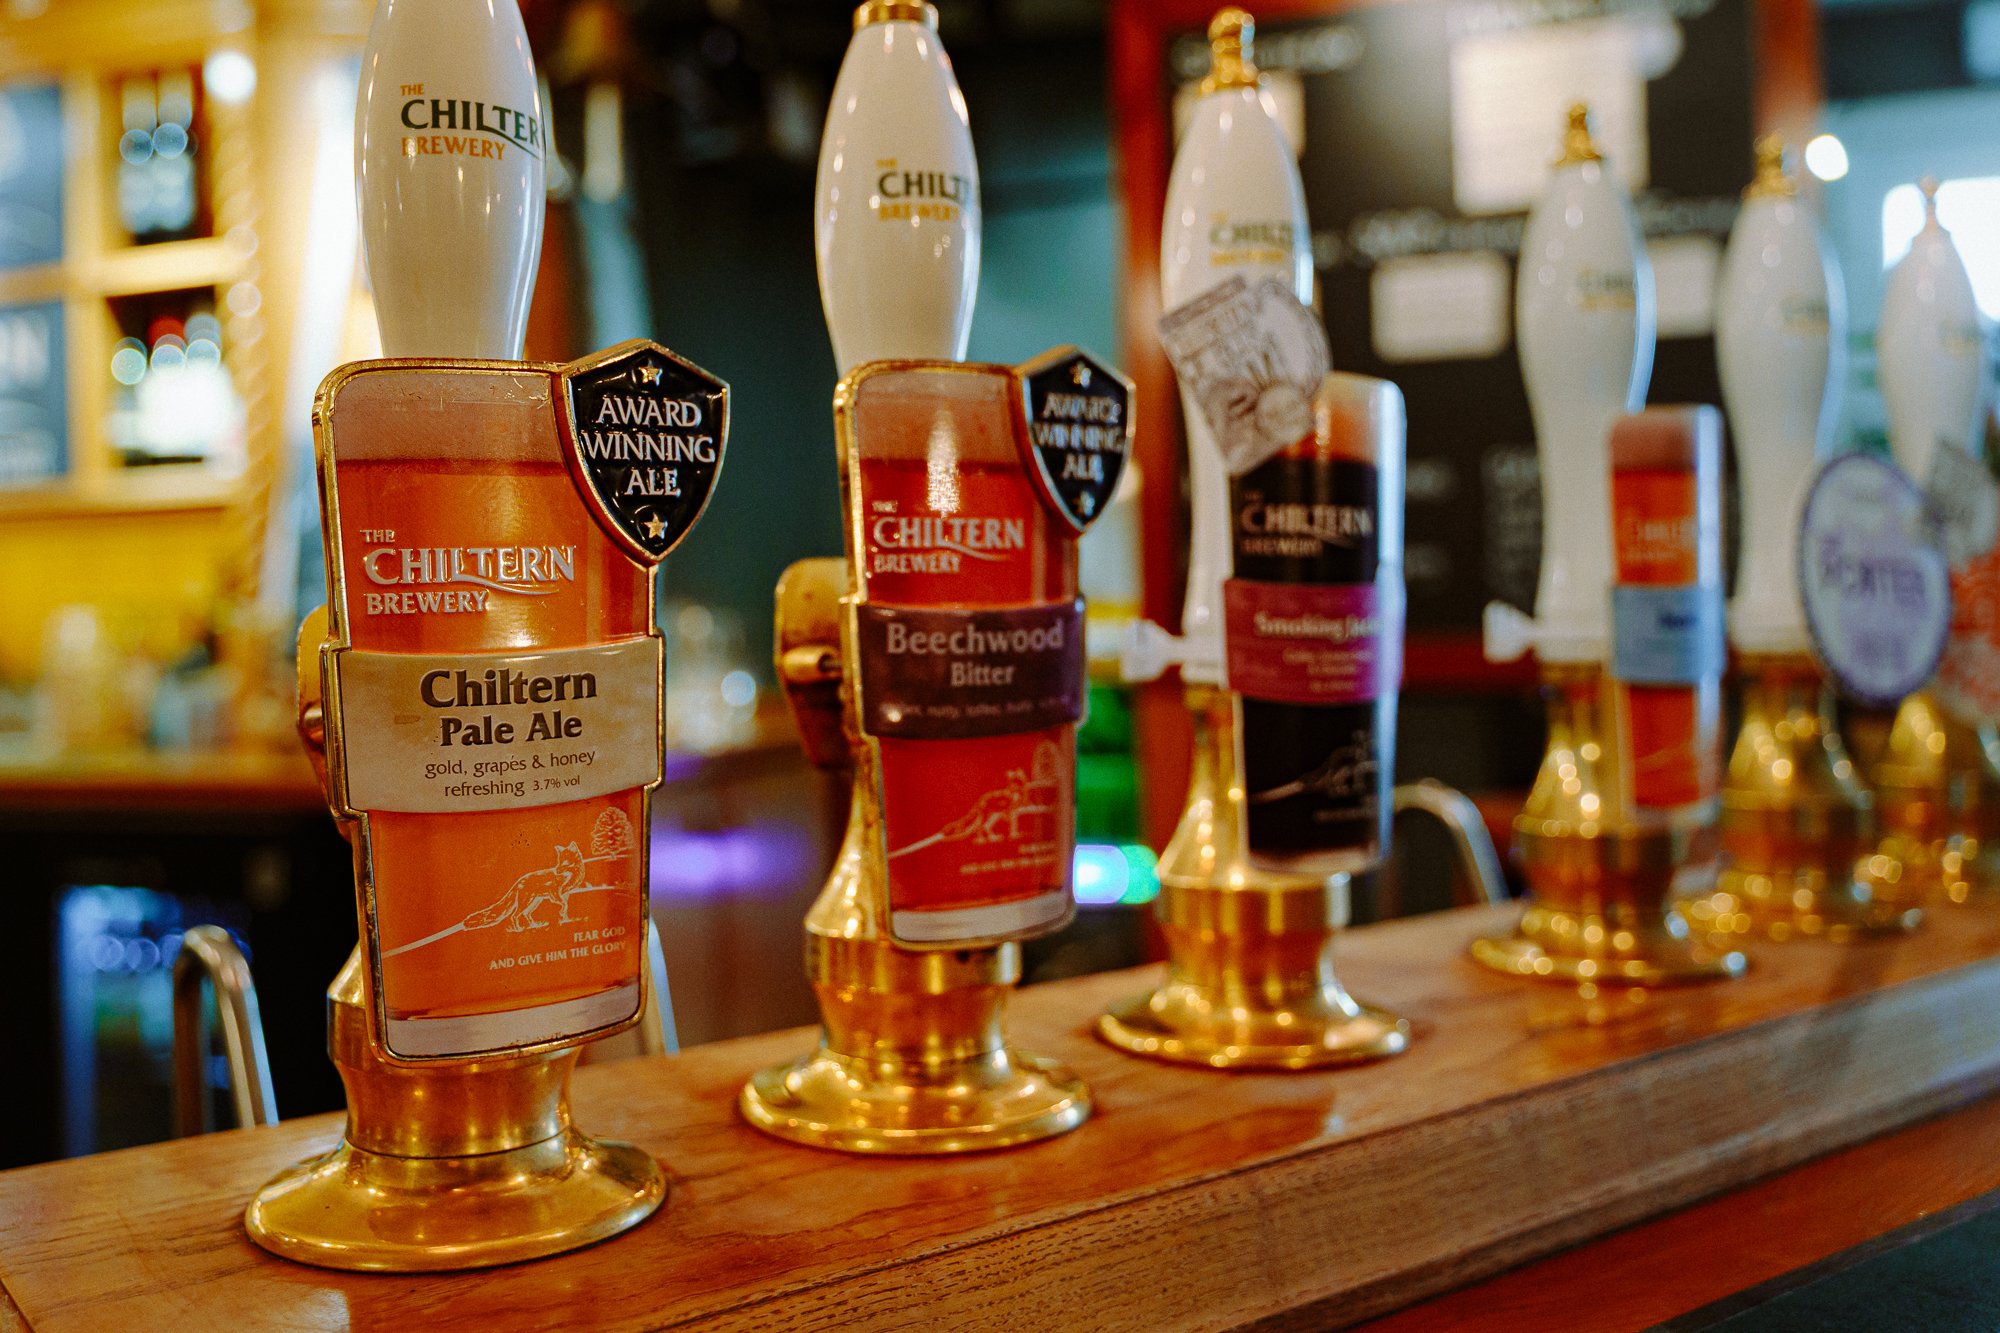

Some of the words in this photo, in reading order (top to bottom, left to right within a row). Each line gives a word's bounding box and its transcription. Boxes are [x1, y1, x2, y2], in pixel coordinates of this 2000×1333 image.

[400, 83, 424, 96] THE
[596, 396, 702, 427] AWARD
[580, 430, 717, 463] WINNING
[625, 468, 682, 496] ALE
[360, 530, 396, 544] THE
[872, 516, 1025, 561] CHILTERN
[363, 545, 578, 595] CHILTERN
[873, 553, 960, 574] BREWERY
[367, 591, 488, 616] BREWERY
[886, 619, 1065, 655] Beechwood
[420, 668, 598, 708] Chiltern
[950, 661, 1016, 688] Bitter
[440, 715, 515, 747] Pale
[526, 710, 583, 742] Ale
[425, 760, 468, 779] gold,
[473, 757, 526, 777] grapes
[532, 755, 546, 769] &
[550, 750, 596, 770] honey
[444, 780, 525, 797] refreshing
[533, 777, 561, 791] 3.7%
[563, 775, 581, 787] vol
[572, 929, 600, 943] FEAR
[602, 926, 626, 938] GOD
[488, 957, 515, 970] AND
[517, 953, 542, 966] GIVE
[545, 950, 568, 962] HIM
[570, 947, 590, 958] THE
[592, 941, 626, 954] GLORY
